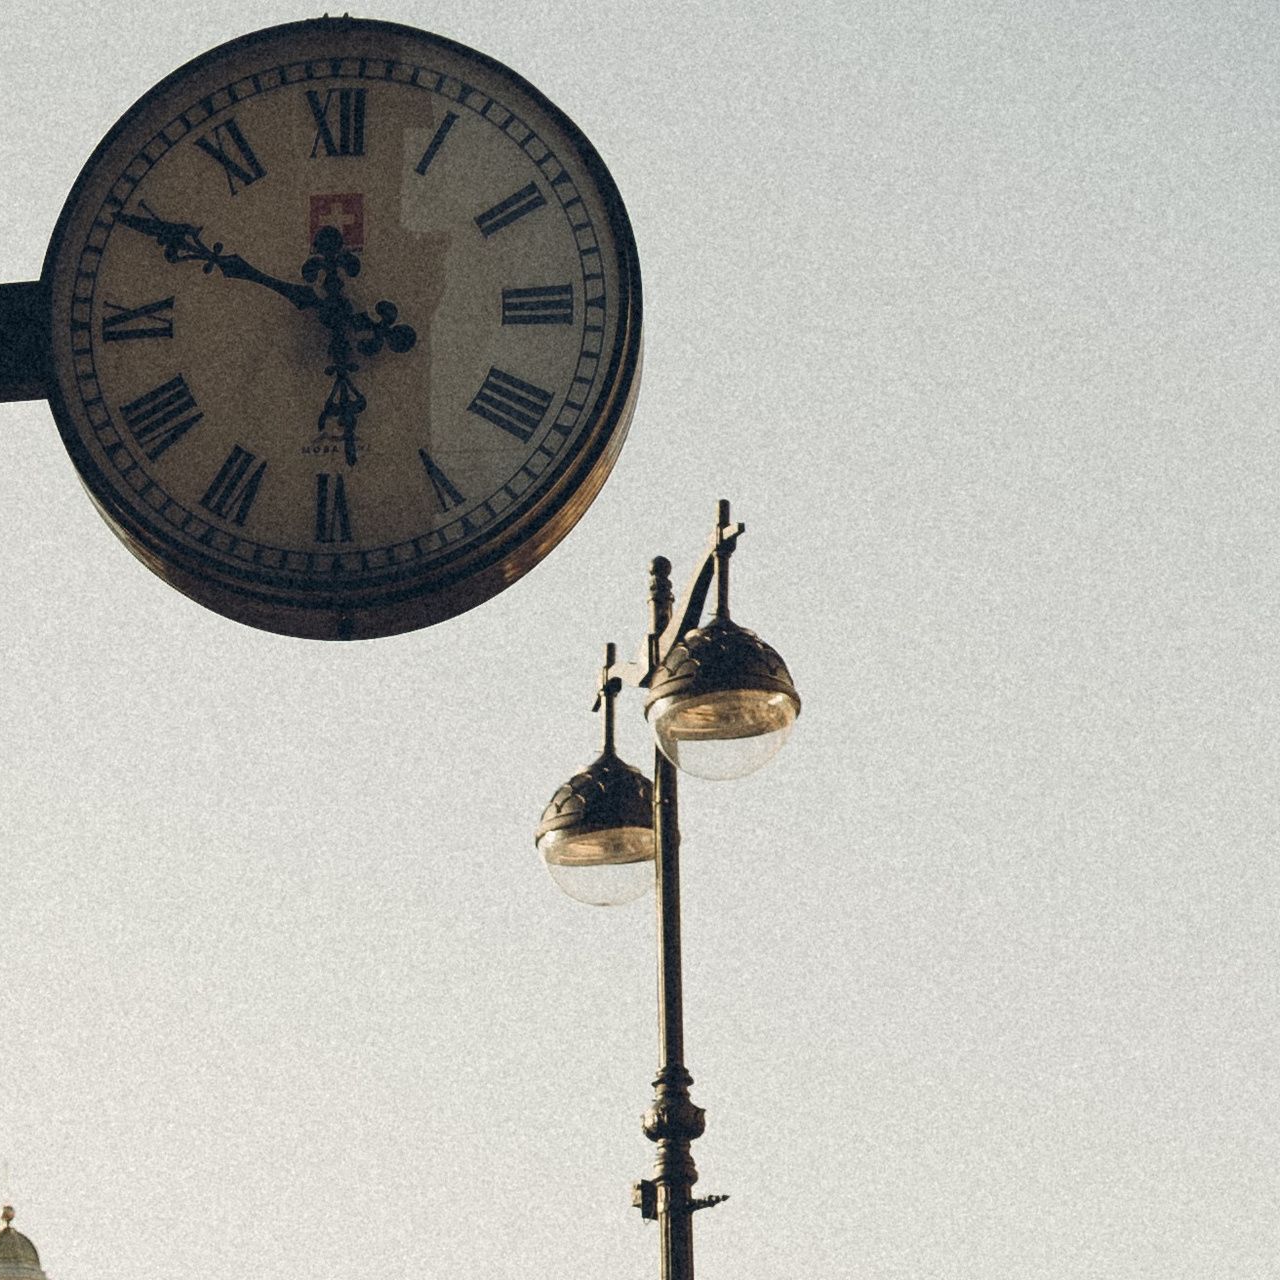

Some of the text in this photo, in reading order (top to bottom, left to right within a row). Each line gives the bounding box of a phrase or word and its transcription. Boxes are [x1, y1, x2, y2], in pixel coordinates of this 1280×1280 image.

[194, 117, 266, 195] XI
[305, 88, 368, 158] XII
[414, 110, 459, 176] I
[474, 181, 547, 238] II
[101, 296, 174, 343] IX
[502, 283, 574, 325] III
[120, 373, 204, 463] VIII
[467, 366, 555, 443] IIII
[200, 444, 267, 527] VII
[314, 474, 354, 543] VI
[419, 447, 467, 512] V
